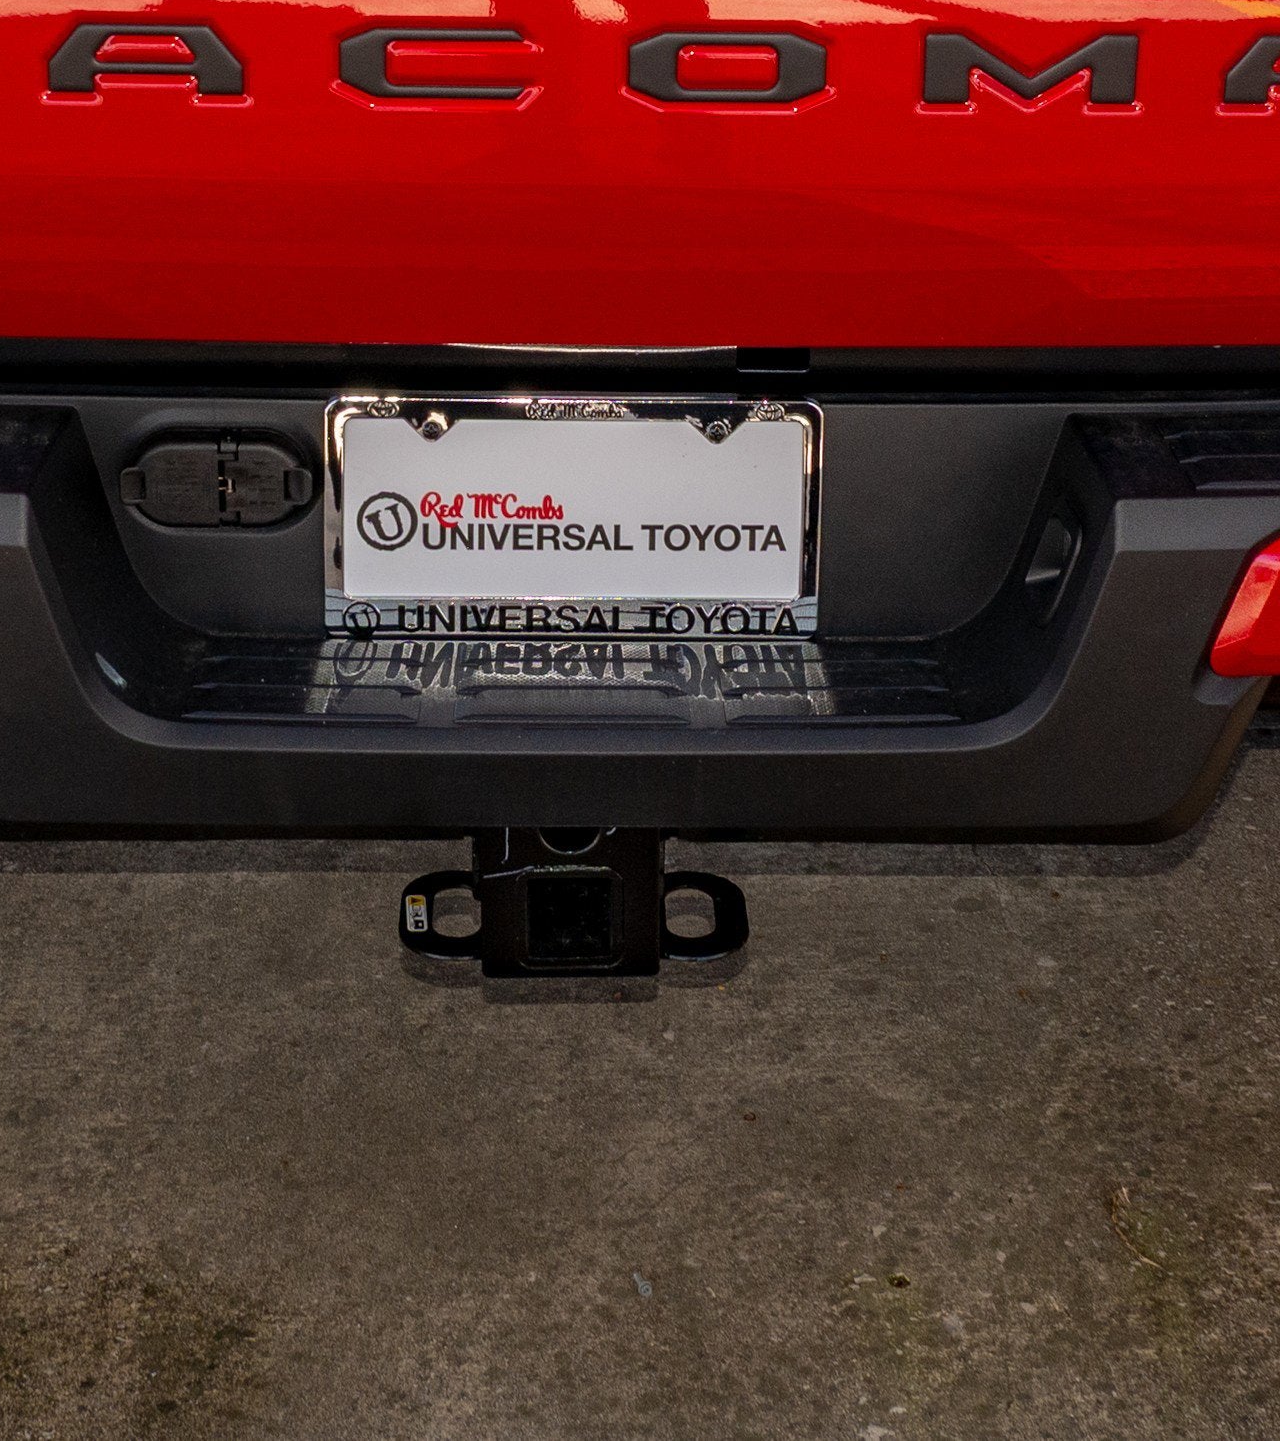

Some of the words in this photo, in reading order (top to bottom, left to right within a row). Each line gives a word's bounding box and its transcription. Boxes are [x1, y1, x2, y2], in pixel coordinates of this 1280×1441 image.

[524, 399, 557, 421] Red
[420, 491, 464, 528] Red
[467, 492, 565, 521] McCombs
[422, 523, 634, 552] UNIVERSAL
[641, 524, 787, 552] TOYOTA
[397, 603, 625, 634] UNIVERSAL
[641, 604, 800, 635] TOYOTA
